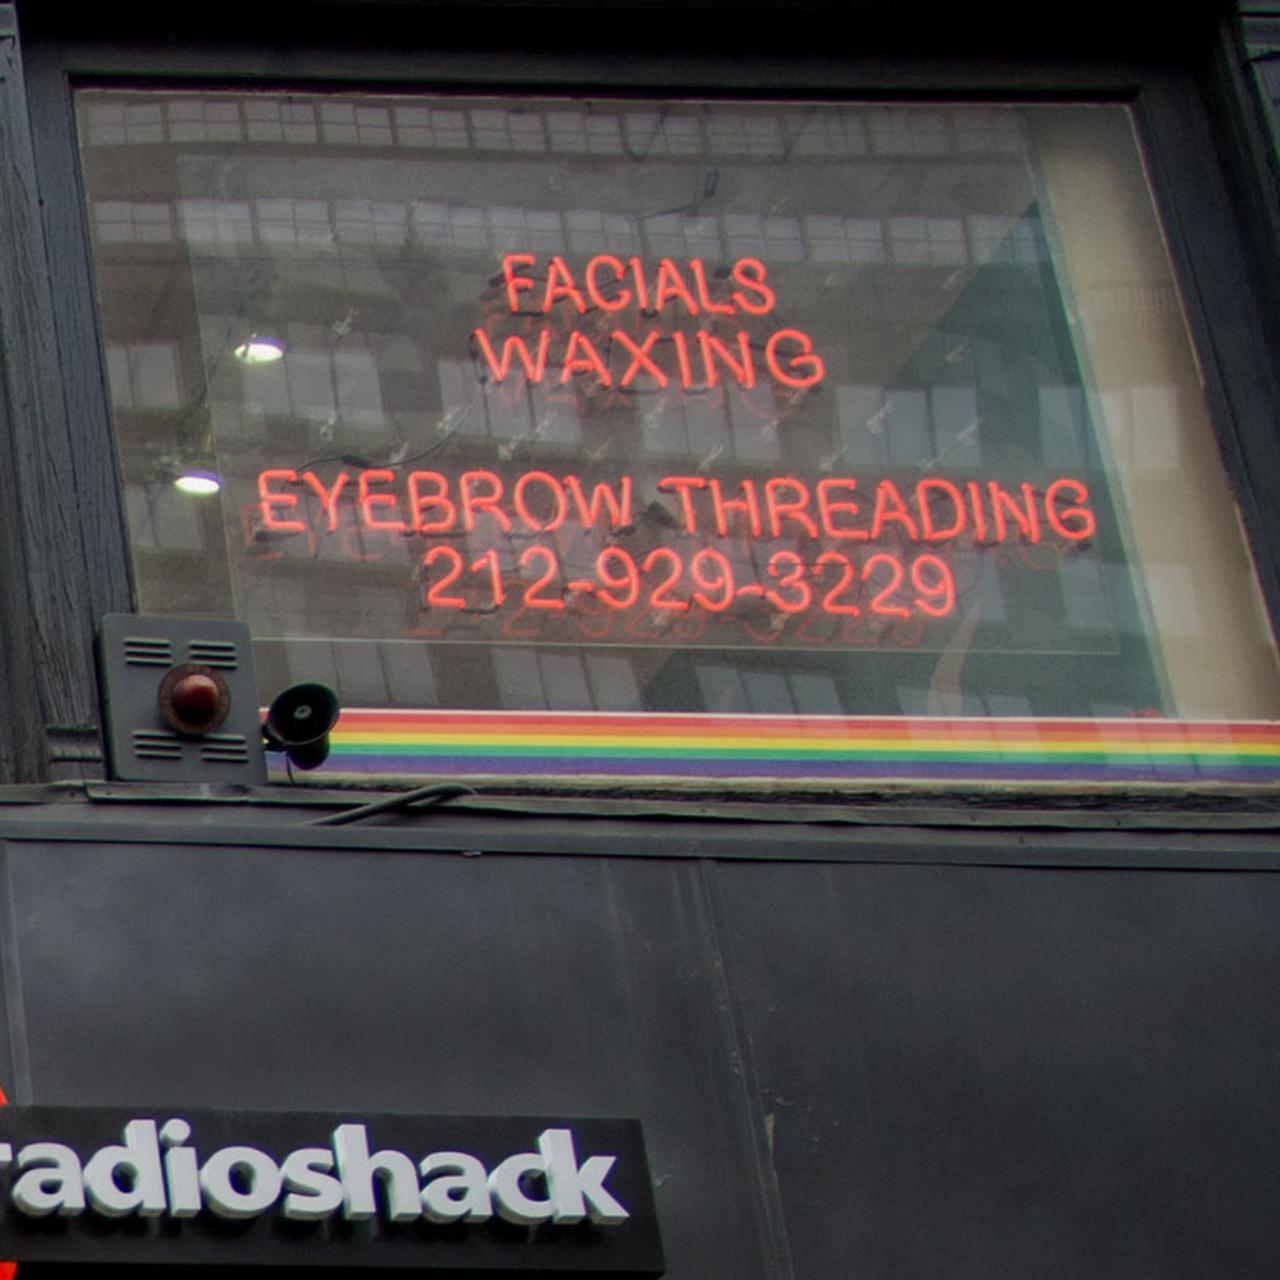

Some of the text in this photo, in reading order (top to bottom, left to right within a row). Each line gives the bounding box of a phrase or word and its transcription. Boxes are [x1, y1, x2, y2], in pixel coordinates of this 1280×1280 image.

[501, 253, 774, 318] FACIALS
[473, 326, 826, 389] WAXING
[257, 469, 1095, 543] EYEBROW THREADING
[425, 545, 956, 619] 212-929-3229
